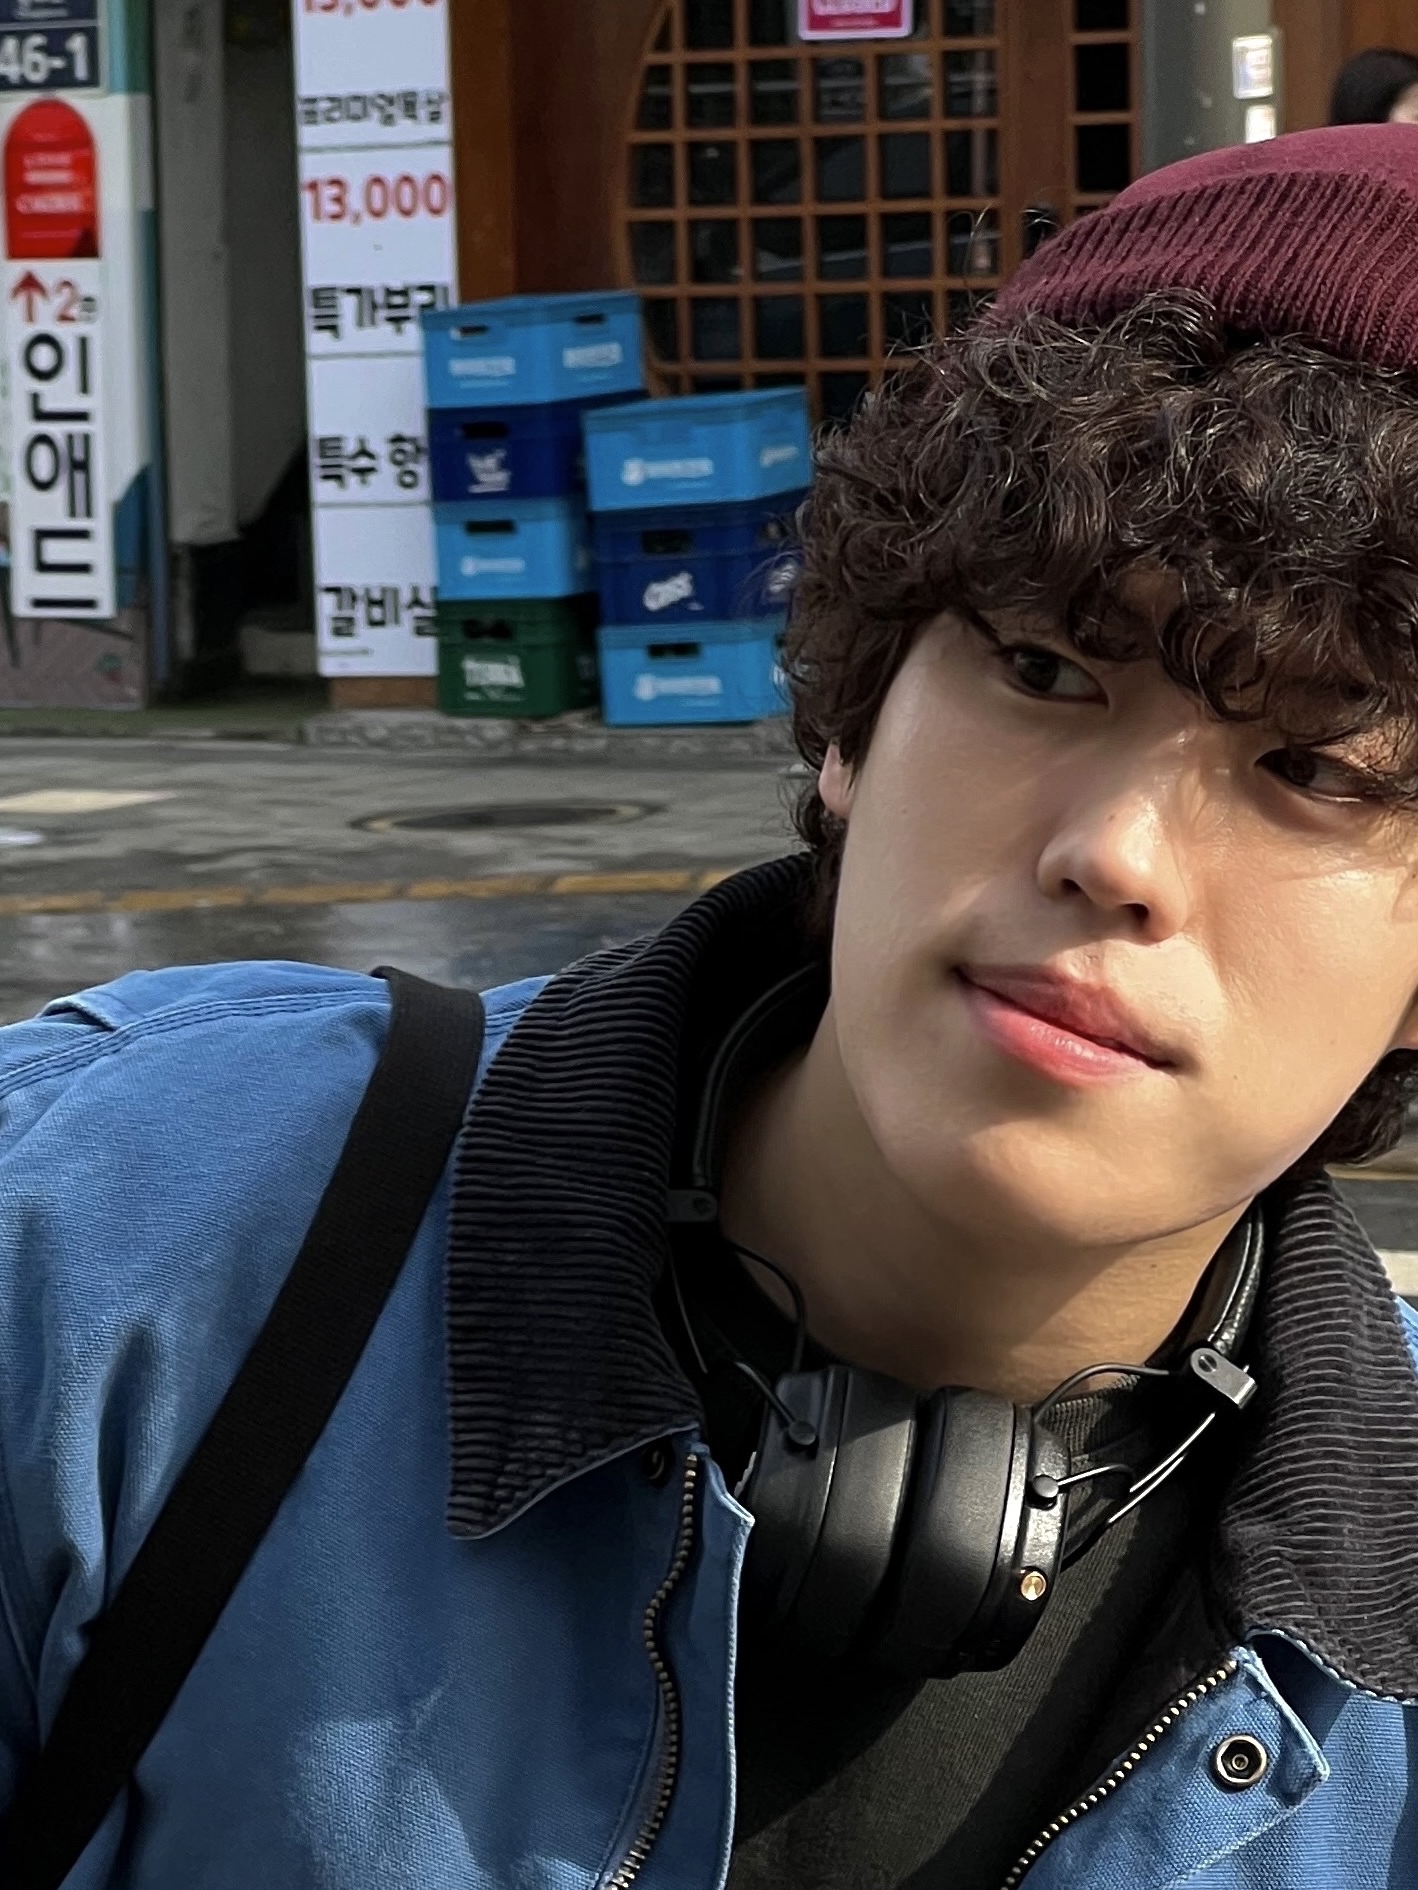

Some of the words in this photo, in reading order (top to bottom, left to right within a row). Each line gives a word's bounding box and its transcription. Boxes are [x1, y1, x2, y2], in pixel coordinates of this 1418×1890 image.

[304, 173, 449, 225] 13,000
[25, 332, 97, 609] 인애드
[317, 436, 378, 490] 특수
